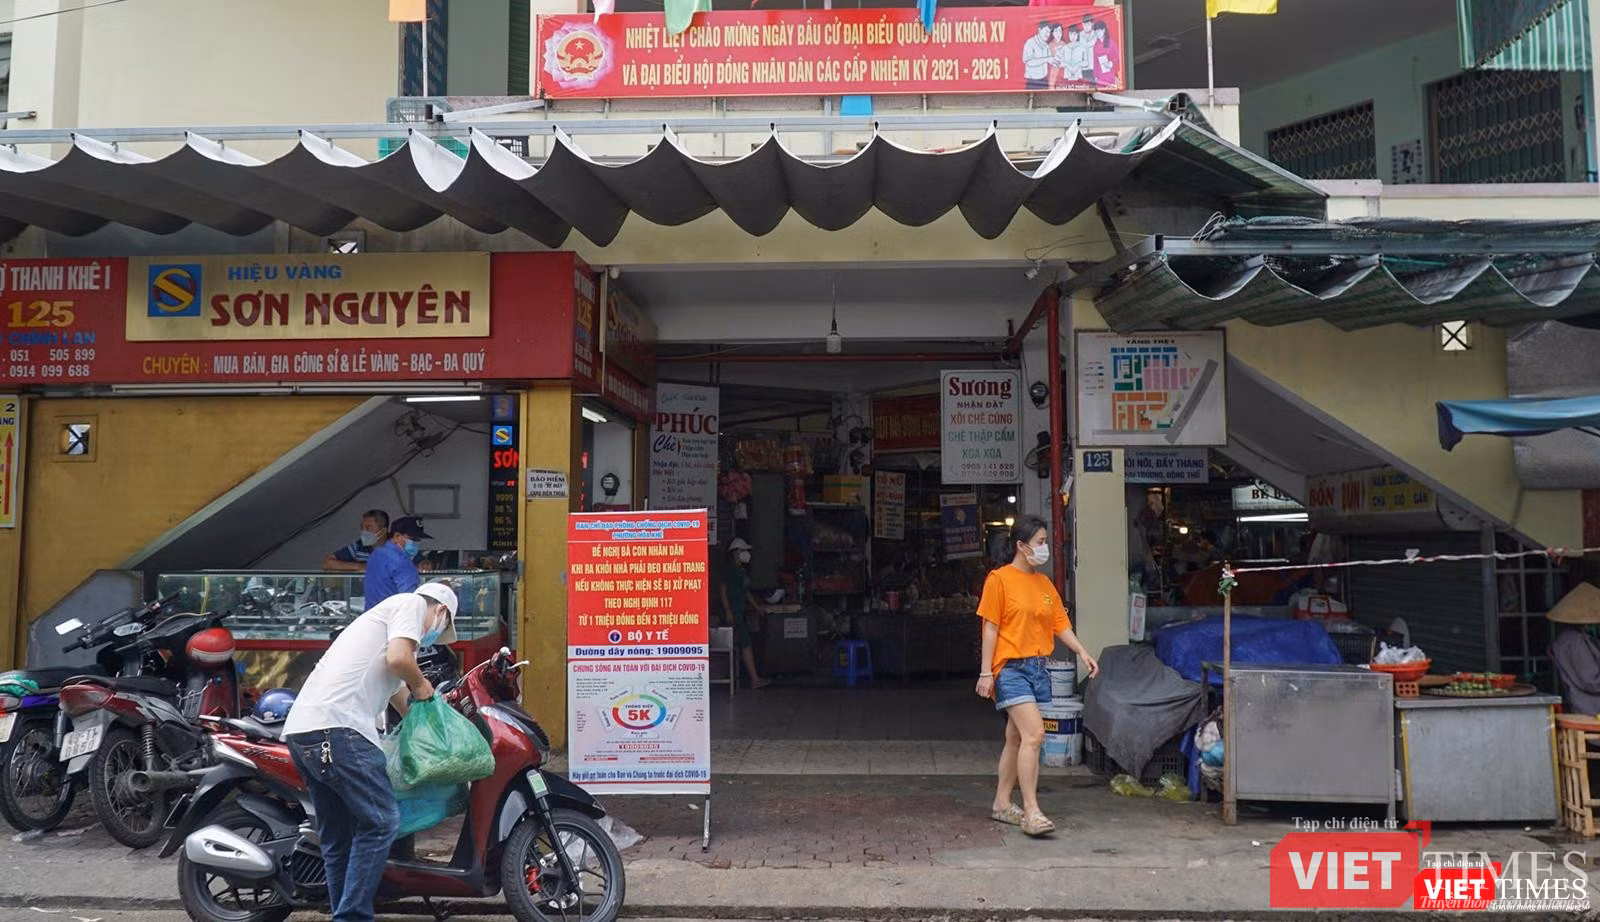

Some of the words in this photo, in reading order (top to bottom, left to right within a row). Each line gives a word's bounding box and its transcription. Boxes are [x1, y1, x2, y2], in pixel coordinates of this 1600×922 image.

[626, 23, 660, 53] NHIỆT
[690, 22, 720, 47] CHÀO
[724, 21, 759, 46] MỪNG
[762, 20, 794, 46] NGÀY
[798, 16, 821, 46] BẦU
[824, 16, 842, 44] CỬ
[844, 23, 863, 49] ĐẠI
[866, 14, 894, 44] BIỂU
[932, 18, 952, 48] HỘI
[955, 16, 988, 43] KHÓA
[990, 21, 1006, 43] XV
[622, 60, 638, 86] VÀ
[640, 64, 660, 90] ĐẠI
[664, 54, 690, 85] BIỂU
[694, 58, 714, 90] HỘI
[716, 54, 749, 84] ĐỒNG
[752, 57, 785, 84] NHÂN
[788, 56, 813, 82] DÂN
[816, 56, 840, 82] CÁC
[844, 53, 868, 82] CẤP
[870, 56, 910, 86] NHIỆM
[913, 54, 928, 81] KỲ
[932, 58, 960, 80] 2021
[972, 58, 1001, 80] 2026
[10, 266, 64, 292] THANH
[68, 262, 100, 290] KHÊ
[228, 263, 278, 283] HIỆU
[285, 262, 342, 280] VÀNG
[210, 289, 290, 327] SƠN
[304, 284, 470, 328] NGUYÊN
[7, 300, 76, 328] 125
[10, 349, 30, 362] 051
[50, 348, 70, 361] 505
[74, 348, 96, 361] 899
[142, 353, 200, 374] CHUYÊN
[214, 354, 238, 374] MUA
[243, 352, 270, 376] BÁN,
[271, 355, 289, 373] GIA
[294, 352, 324, 374] CÔNG
[327, 348, 339, 373] SỈ
[340, 356, 350, 373] &
[352, 348, 366, 373] LẺ
[370, 350, 400, 373] VÀNG
[410, 353, 432, 375] BẠC
[444, 354, 459, 372] ĐA
[462, 348, 485, 374] QUÝ
[10, 364, 36, 378] 0914
[41, 364, 64, 378] 099
[68, 364, 90, 377] 688
[949, 376, 1012, 400] Sương
[6, 402, 15, 412] 2
[958, 400, 982, 410] NHẬN
[986, 400, 1004, 410] ĐẶT
[656, 407, 717, 436] PHÚC
[950, 412, 966, 425] XÔI
[968, 411, 986, 424] CHÈ
[988, 411, 1013, 424] CÚNG
[654, 434, 676, 453] Chè
[969, 428, 992, 444] THẬP
[1086, 453, 1110, 468] 125
[603, 546, 620, 558] NGHỊ
[622, 544, 631, 556] BÀ
[632, 546, 647, 556] CON
[648, 545, 668, 556] NHÂN
[670, 545, 684, 556] DÂN
[571, 564, 583, 574] KHI
[585, 564, 594, 574] RA
[596, 561, 612, 574] KHỎI
[613, 561, 628, 574] NHÀ
[630, 561, 646, 574] PHẢI
[647, 563, 661, 573] ĐEO
[662, 559, 681, 573] KHẨU
[682, 562, 705, 573] TRANG
[575, 578, 589, 591] NẾU
[591, 579, 614, 591] KHÔNG
[616, 580, 634, 593] THỰC
[635, 579, 652, 593] HIỆN
[664, 580, 671, 593] BỊ
[684, 579, 702, 592] PHẠT
[604, 598, 622, 608] THEO
[623, 598, 640, 610] NGHỊ
[642, 598, 658, 610] ĐỊNH
[660, 598, 672, 608] 117
[578, 613, 588, 626] TỪ
[589, 616, 592, 626] 1
[595, 613, 614, 628] TRIỆU
[616, 611, 635, 626] ĐỒNG
[636, 611, 650, 625] ĐẾN
[652, 615, 657, 625] 3
[659, 612, 678, 627] TRIỆU
[680, 611, 699, 624] ĐỒNG
[627, 630, 642, 642] BỘ
[646, 631, 654, 640] Y
[656, 628, 669, 640] TẾ
[575, 647, 605, 656] Đường
[608, 647, 624, 656] dây
[627, 647, 654, 656] nóng:
[657, 646, 703, 655] 19009095
[594, 663, 612, 672] SỐNG
[613, 664, 622, 672] AN
[623, 663, 638, 672] TOÀN
[640, 663, 650, 672] VỚI
[651, 664, 662, 673] ĐẠI
[662, 663, 676, 673] DỊCH
[678, 663, 705, 672] COVID-19
[628, 710, 650, 720] 5K
[685, 770, 706, 778] COVID-19
